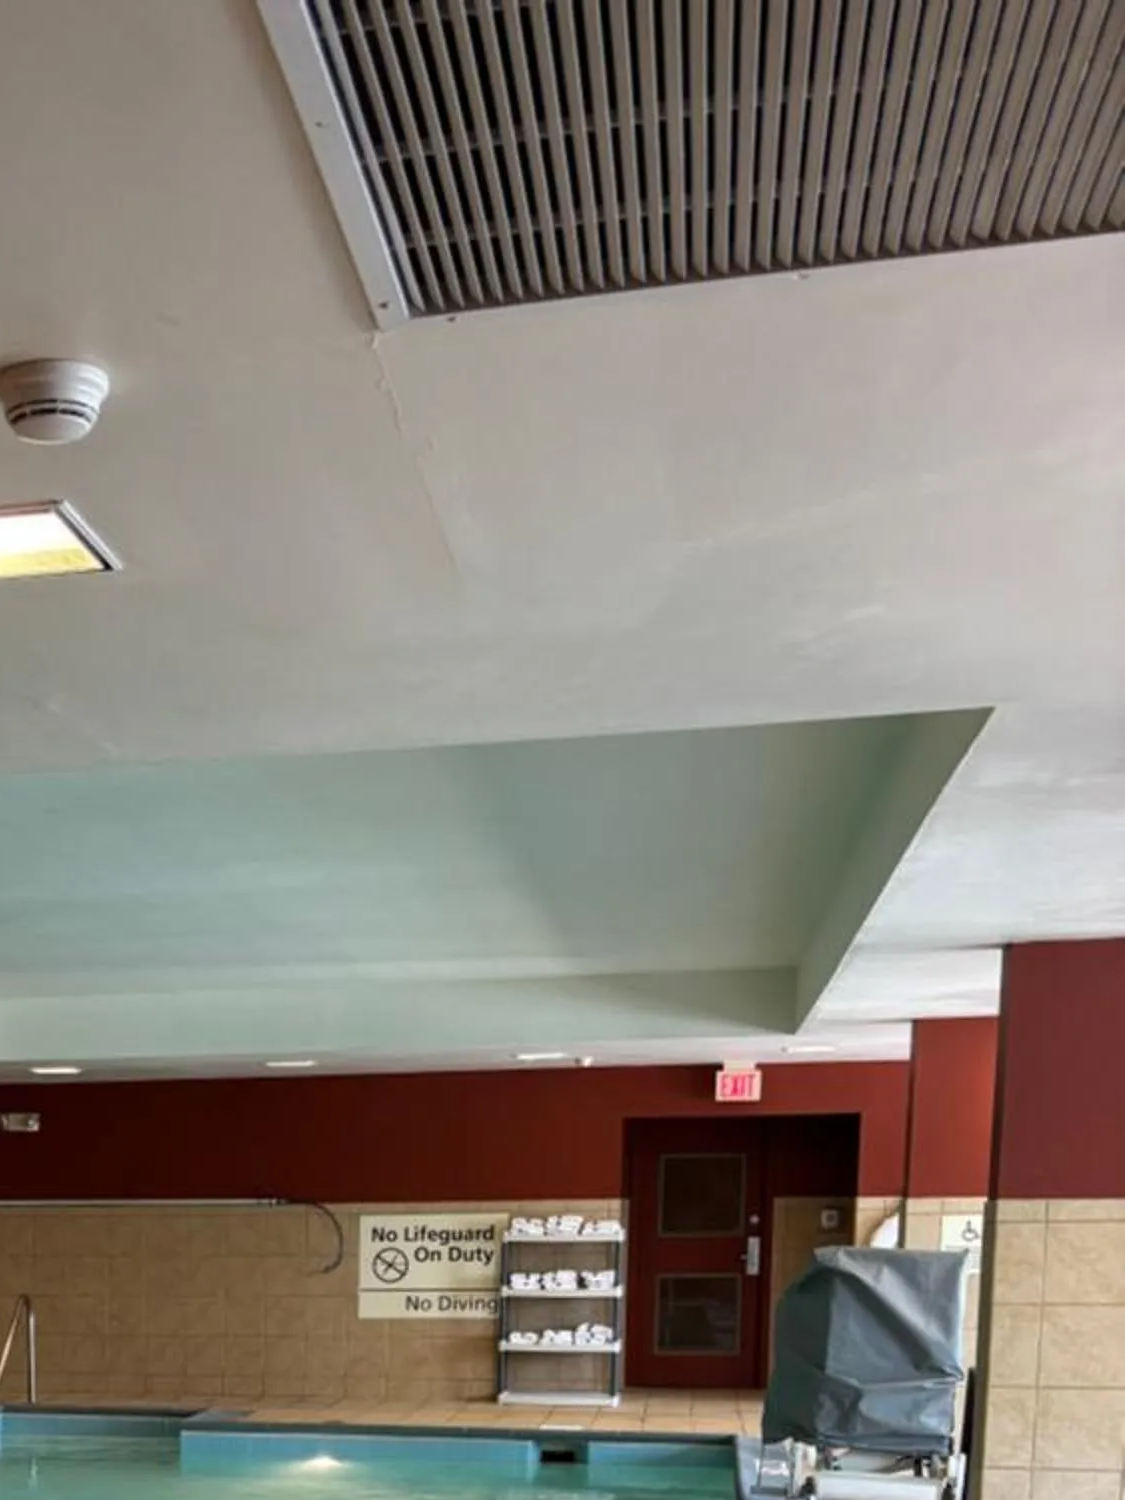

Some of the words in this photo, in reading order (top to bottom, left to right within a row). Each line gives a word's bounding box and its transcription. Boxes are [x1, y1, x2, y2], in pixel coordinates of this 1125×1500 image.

[720, 1074, 756, 1097] EXIT
[371, 1227, 398, 1242] No
[404, 1224, 495, 1246] Lifeguard
[414, 1246, 441, 1263] On
[448, 1246, 494, 1266] Duty
[405, 1296, 432, 1312] No
[438, 1295, 498, 1314] Diving
